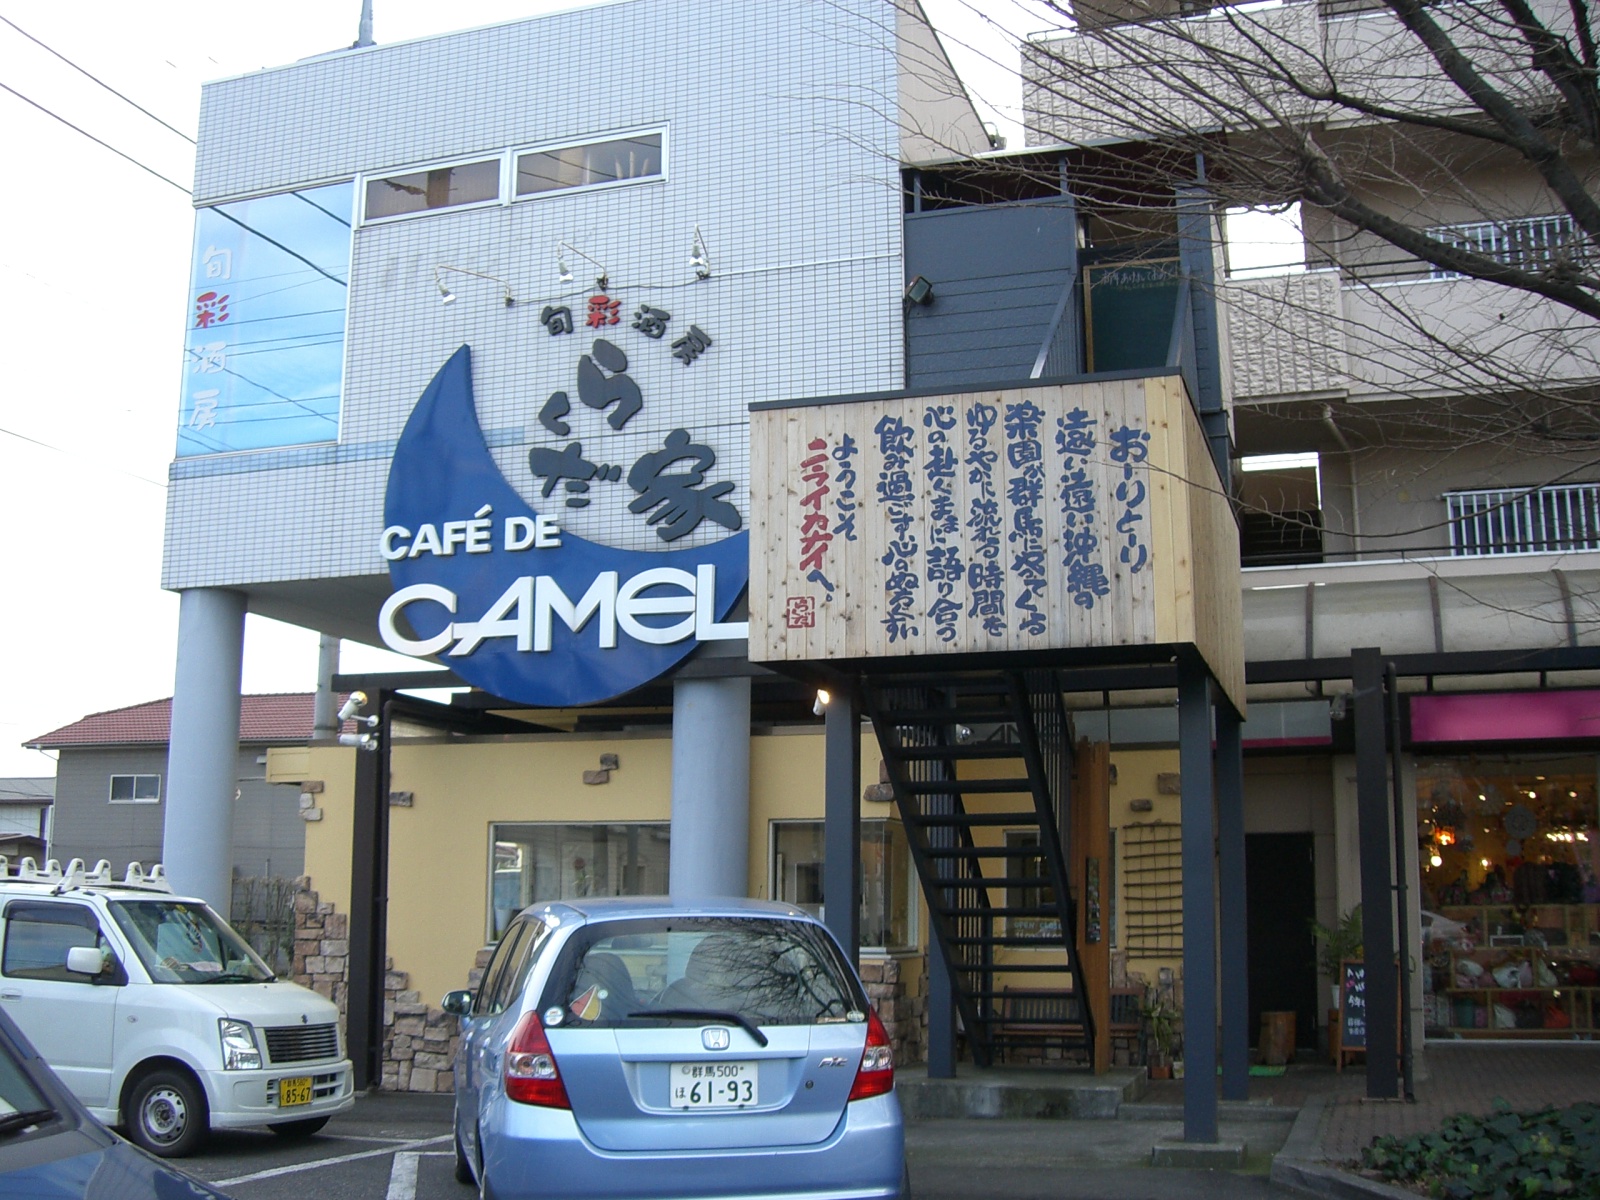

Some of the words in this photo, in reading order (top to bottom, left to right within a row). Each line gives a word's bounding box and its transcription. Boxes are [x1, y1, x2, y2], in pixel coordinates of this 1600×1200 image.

[378, 503, 494, 562] CAFÉ
[503, 513, 563, 552] DE
[831, 432, 859, 542] ようこそ
[873, 414, 919, 643] 飲み過ごす心のぬちぐすい
[923, 404, 966, 643] 心の赴くままに語り合う
[965, 401, 1008, 637] ゆるやかに流れる時間を
[1004, 399, 1048, 636] 楽園が群馬にやってくる
[1055, 406, 1111, 610] 遠い遠い沖縄の
[1109, 425, 1151, 574] おーりとーり
[378, 563, 749, 657] CAMEL
[286, 1087, 311, 1104] 85-67
[689, 1080, 753, 1104] 61-93
